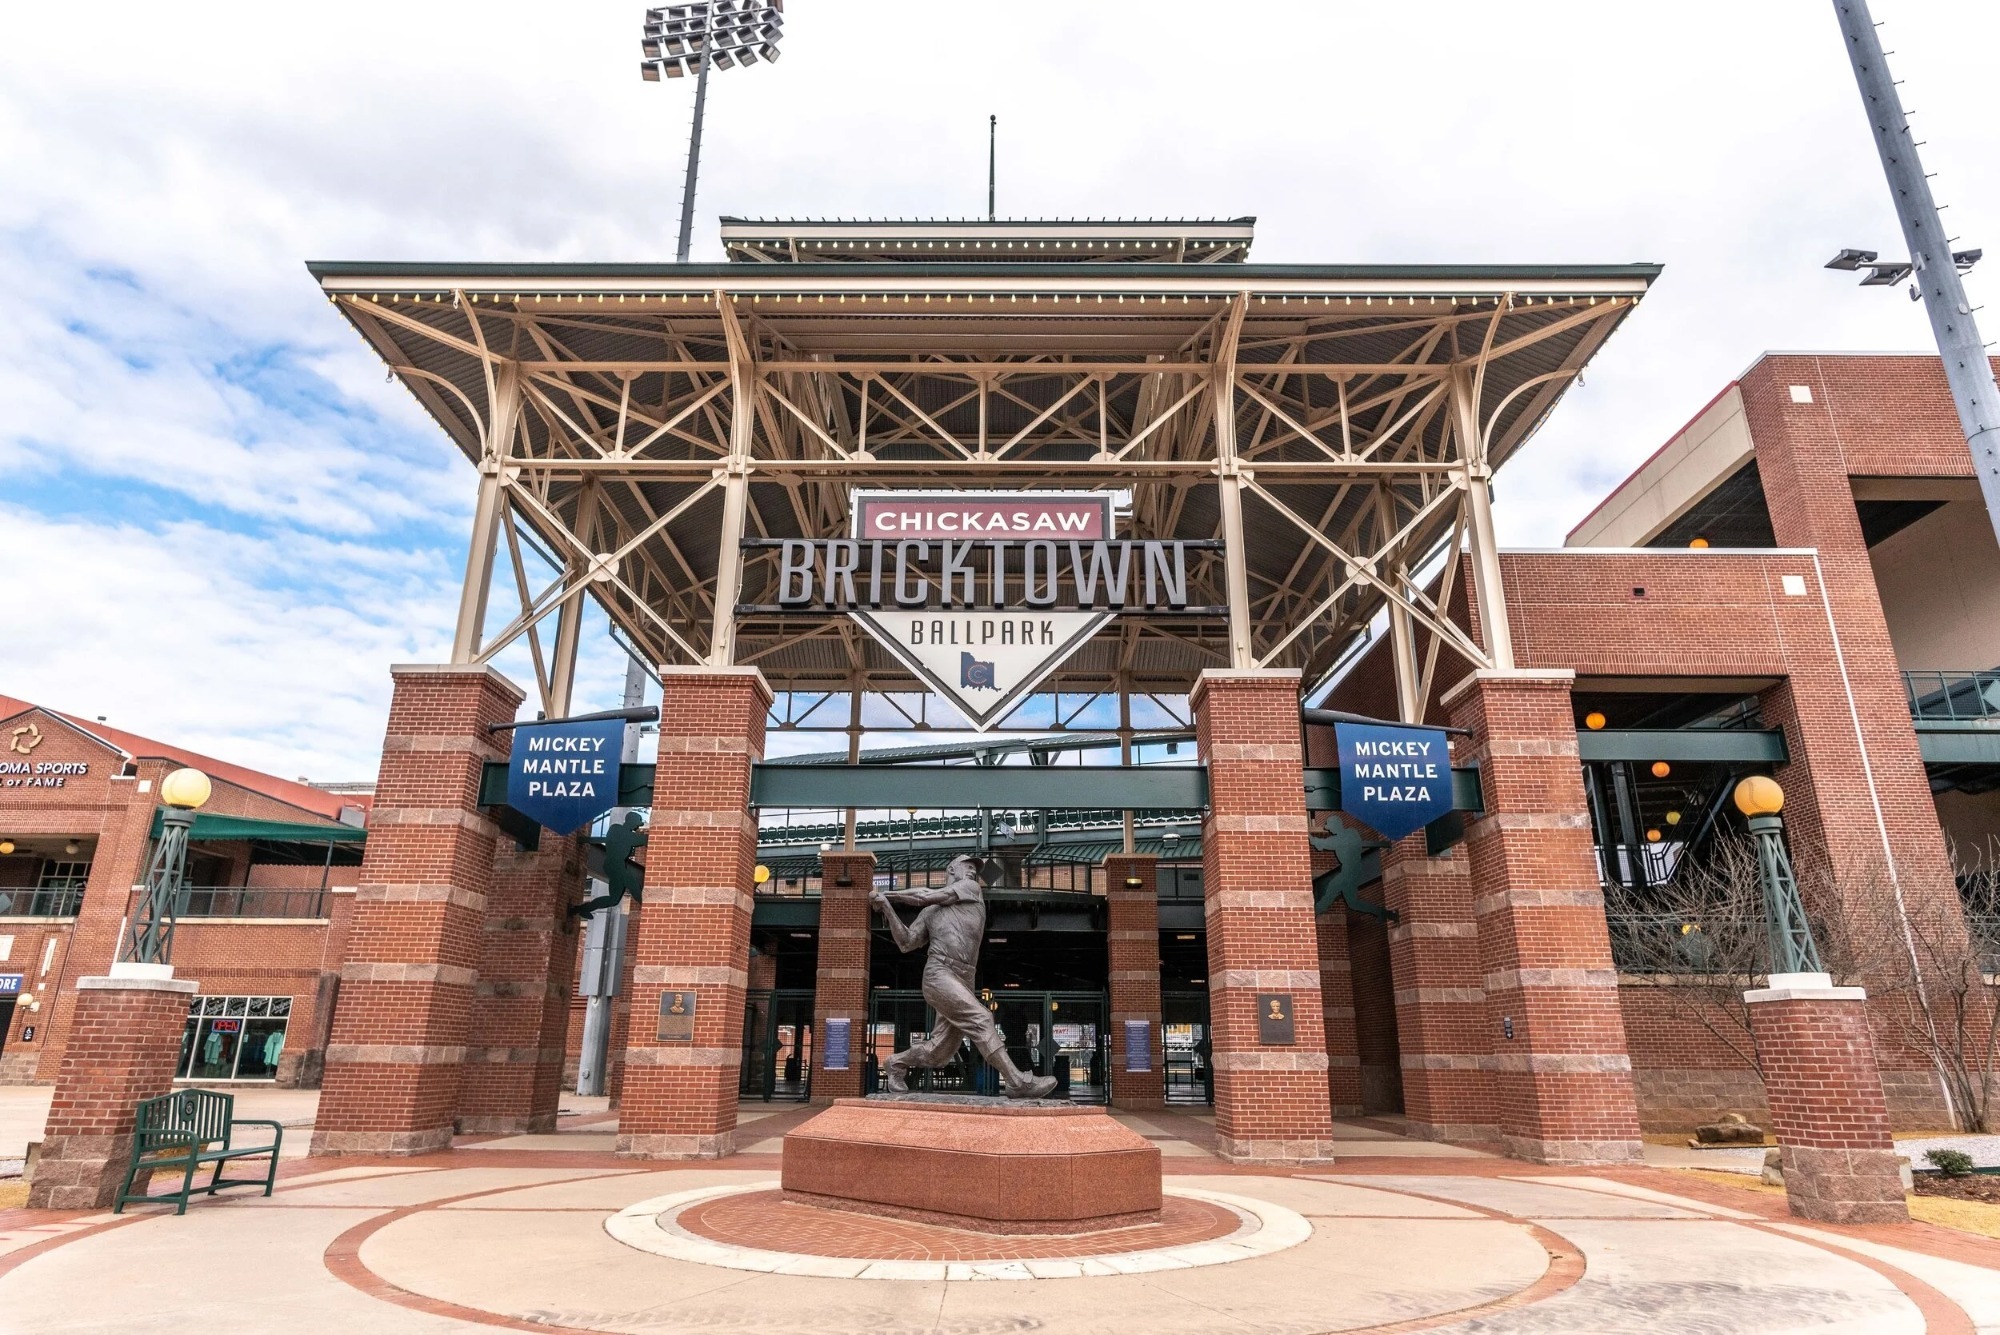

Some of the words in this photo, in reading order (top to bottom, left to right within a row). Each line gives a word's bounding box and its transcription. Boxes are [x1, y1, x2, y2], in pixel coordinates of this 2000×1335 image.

[875, 512, 1091, 531] CHICKASAW
[779, 539, 1187, 606] BRICKTOWN
[911, 620, 1054, 645] BALLPARK
[528, 737, 606, 752] MICKEY
[1355, 741, 1431, 756] MICKEY
[35, 762, 88, 775] SPORTS
[523, 758, 605, 775] MANTLE
[1355, 763, 1438, 779] MANTLE
[27, 777, 65, 787] FAME
[528, 781, 596, 797] PLAZA
[1363, 786, 1432, 802] PLAZA
